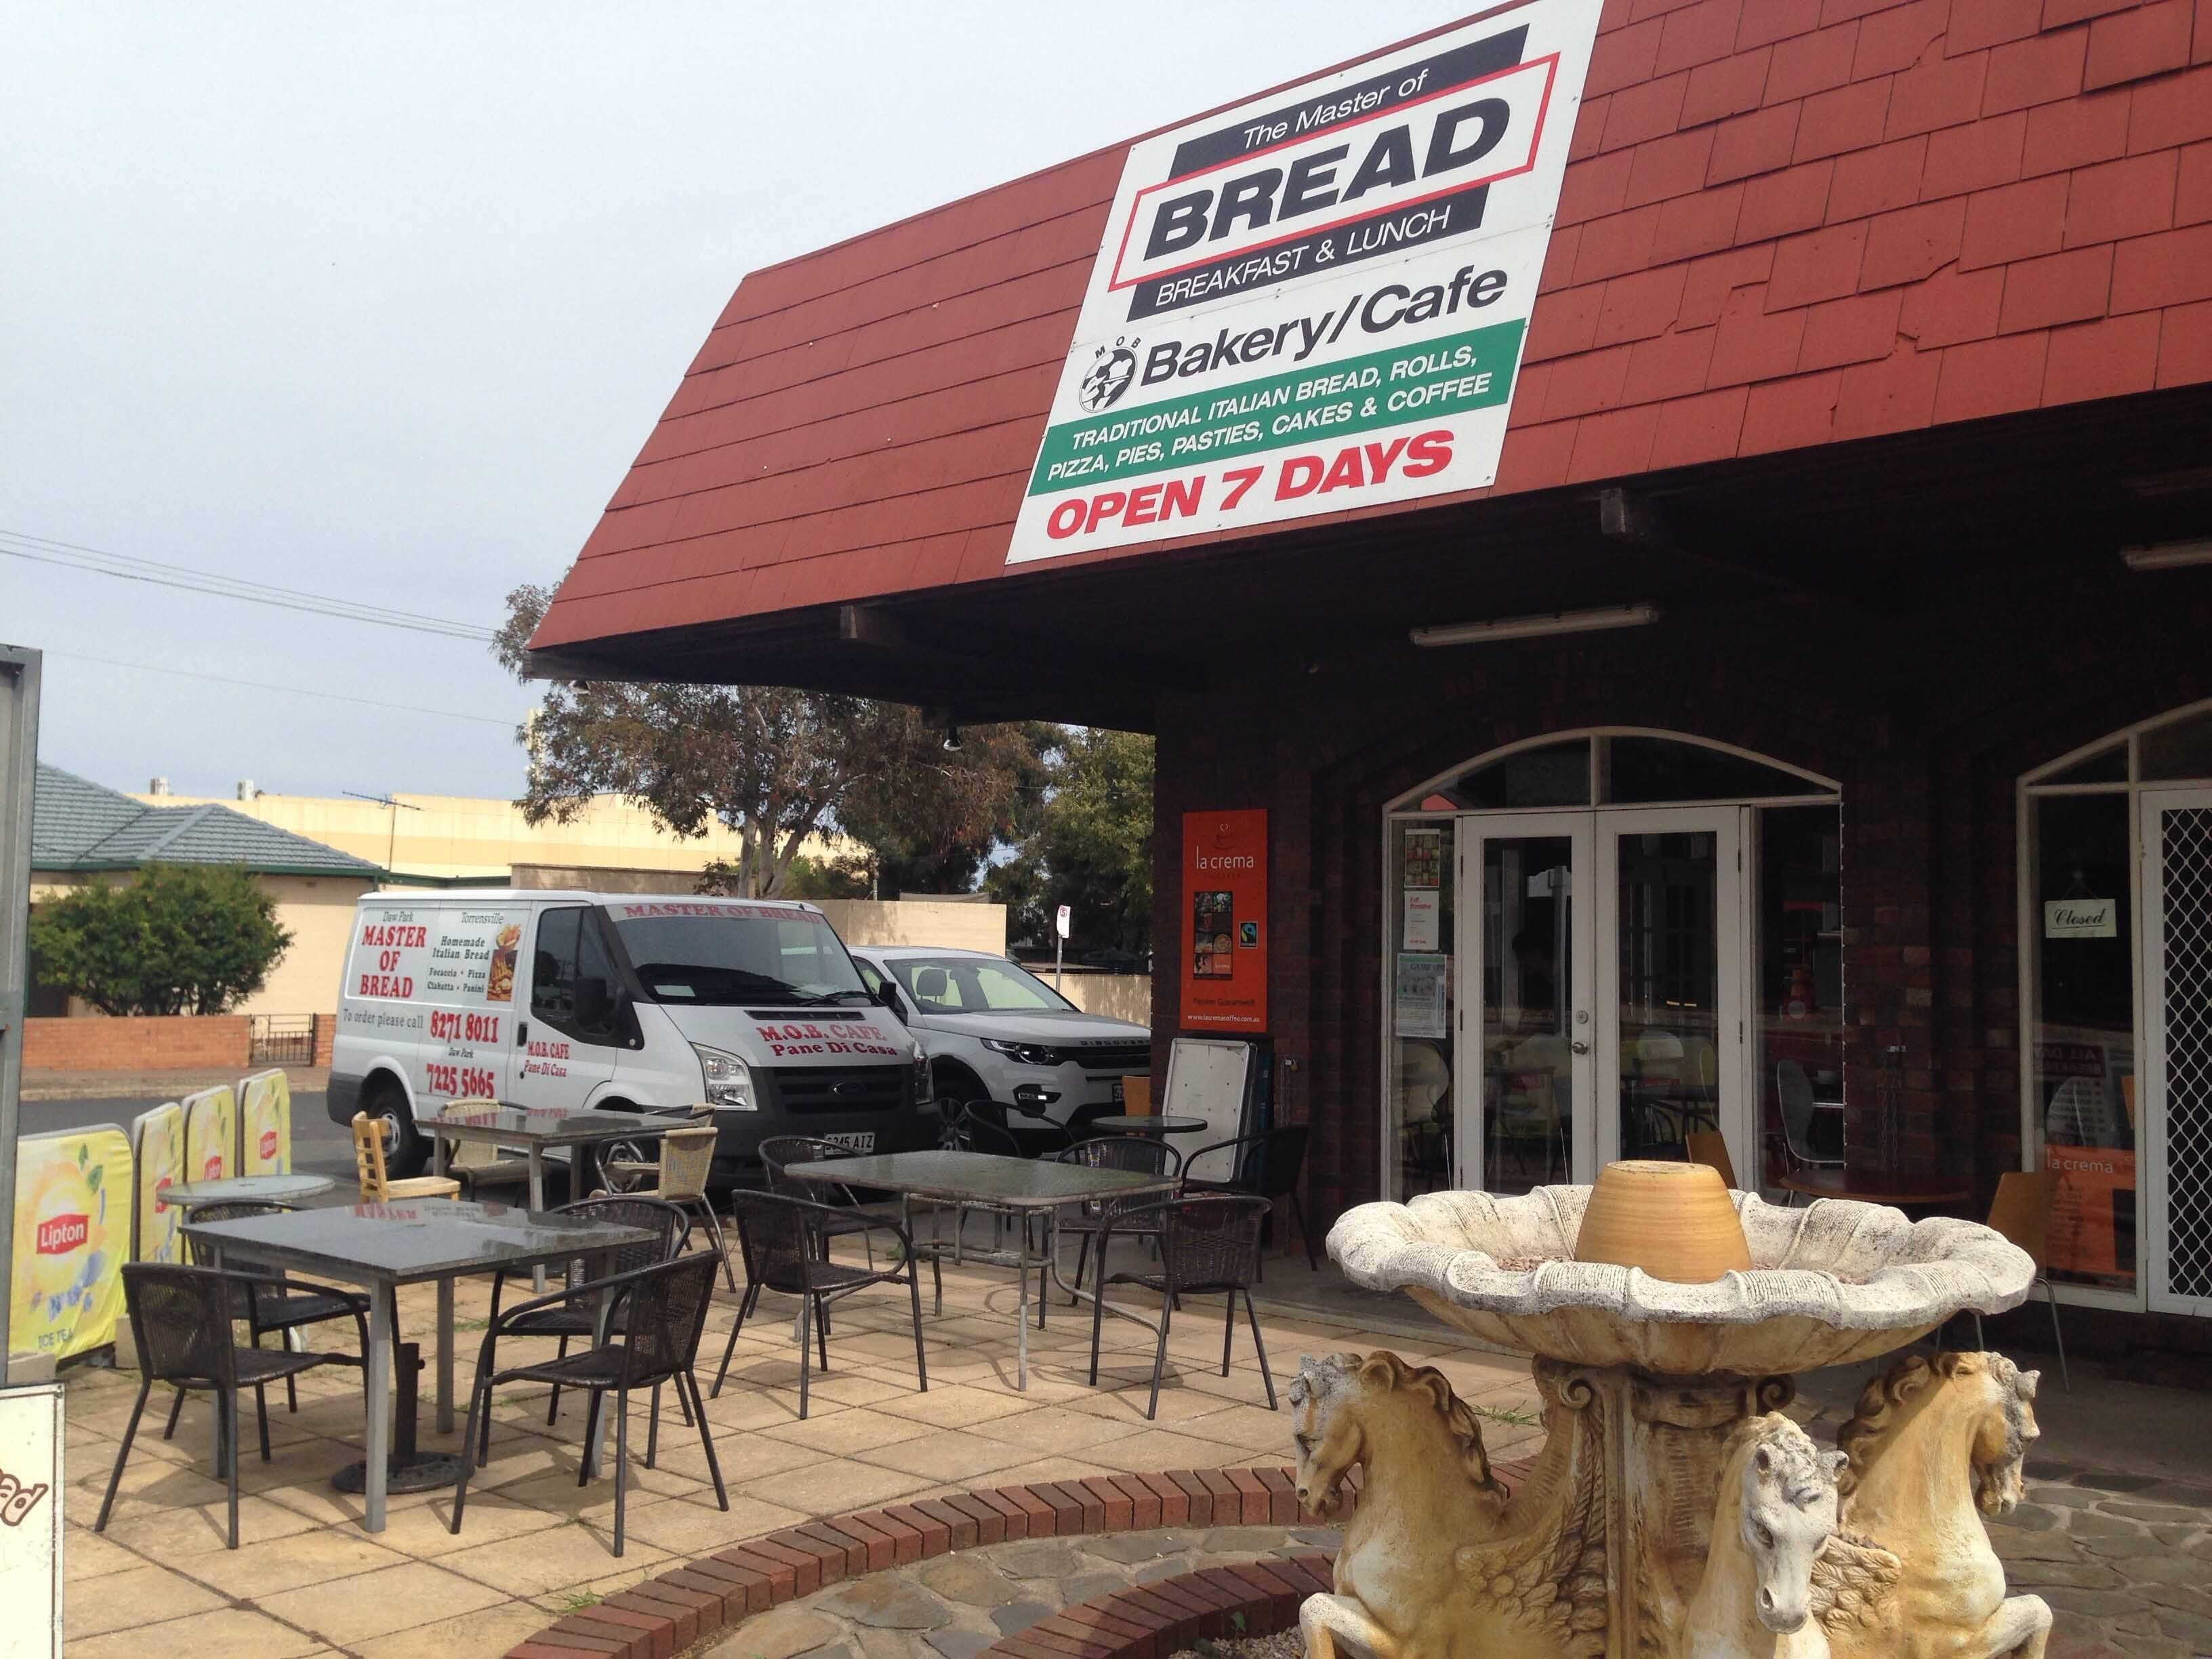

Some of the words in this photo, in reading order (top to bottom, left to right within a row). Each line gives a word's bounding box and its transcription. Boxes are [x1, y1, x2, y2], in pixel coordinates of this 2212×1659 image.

[1243, 122, 1287, 150] The
[1296, 89, 1391, 134] Master
[1398, 68, 1429, 100] of
[1143, 96, 1510, 262] BREAD
[1155, 245, 1309, 308] BREAKFAST
[1315, 239, 1334, 263] &
[1347, 205, 1450, 253] LUNCH
[1141, 264, 1507, 386] Bakery/Cafe
[1072, 405, 1202, 450] TRADITIONAL
[1208, 386, 1290, 422] ITALIAN
[1298, 367, 1382, 403] BREAD,
[1389, 346, 1477, 381] ROLLS,
[1048, 449, 1109, 481] PIZZA,
[1115, 438, 1165, 469] PIES,
[1172, 421, 1263, 457] PASTIES,
[1271, 403, 1352, 436] CAKES
[1360, 396, 1376, 417] &
[1387, 373, 1492, 411] COFFEE
[1047, 480, 1211, 539] OPEN
[1218, 466, 1264, 510] 7
[1274, 430, 1454, 503] DAYS
[1196, 846, 1207, 869] la
[1210, 856, 1254, 869] crema
[398, 912, 414, 922] Park
[461, 912, 504, 924] Torrensville
[623, 903, 721, 918] MASTER
[726, 907, 754, 917] OF
[759, 907, 820, 924] BREAD
[2054, 908, 2106, 925] Closed
[361, 926, 427, 947] MASTER
[441, 936, 485, 947] Homemade
[380, 950, 401, 971] OF
[432, 948, 459, 959] Italian
[464, 949, 489, 960] Bread
[429, 968, 457, 977] Focaccia
[468, 969, 486, 979] Pizza
[359, 975, 413, 998] BREAD
[428, 981, 453, 991] Ciabatta
[463, 983, 484, 992] Panini
[343, 1008, 352, 1021] To
[354, 1010, 375, 1025] order
[377, 1015, 404, 1029] please
[407, 1015, 424, 1029] call
[430, 1010, 462, 1044] 8271
[466, 1013, 499, 1043] 8011
[756, 1024, 830, 1042] M.O.B.
[830, 1024, 887, 1041] CAFE
[460, 1048, 474, 1059] Park
[527, 1041, 548, 1057] M.O.B.
[550, 1042, 569, 1059] CAFE
[770, 1043, 823, 1056] Pane
[825, 1042, 851, 1053] Di
[853, 1042, 897, 1056] Casa
[524, 1060, 540, 1073] Pane
[551, 1063, 567, 1077] Casa
[427, 1063, 457, 1096] 7225
[462, 1067, 495, 1099] 5665
[2047, 1148, 2060, 1169] la
[2064, 1160, 2113, 1174] crema
[41, 1223, 85, 1252] Lipton
[38, 1332, 54, 1349] ICE
